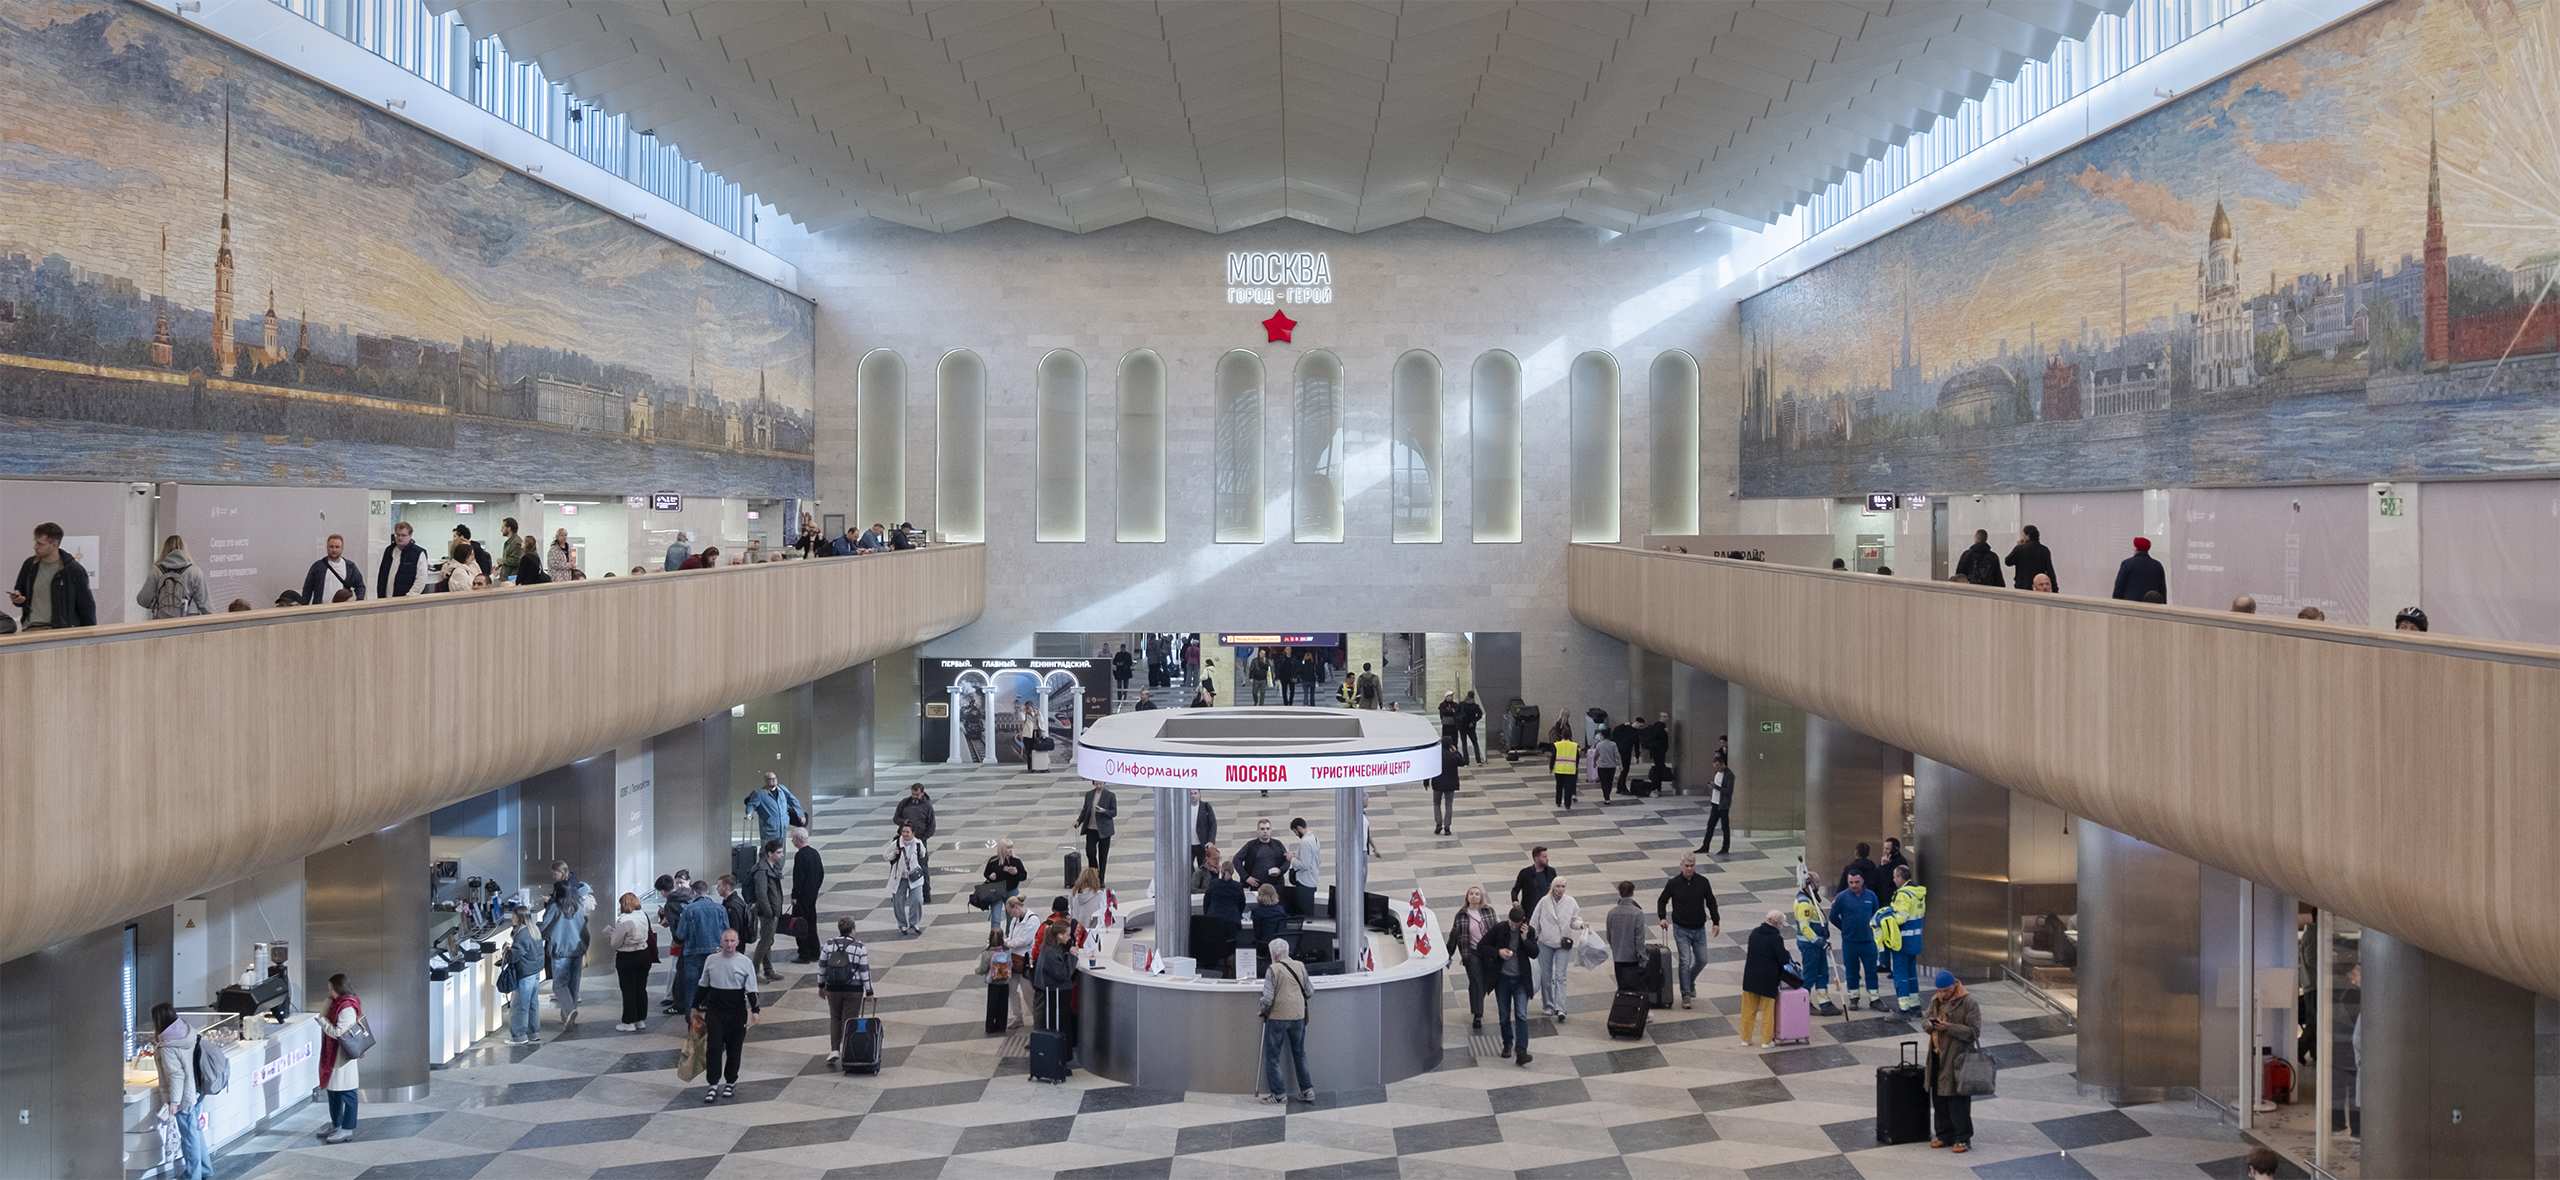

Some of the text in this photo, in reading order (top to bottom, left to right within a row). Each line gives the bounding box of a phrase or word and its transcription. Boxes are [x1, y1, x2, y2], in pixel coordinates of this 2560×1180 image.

[1228, 253, 1331, 284] МОСКВА
[1228, 287, 1274, 304] ГОРОД
[1286, 286, 1332, 304] ГЕРОЙ
[941, 659, 1092, 669] ПЕРВЫЙ. ГЛАВНЫЙ. ЛЕНИНГРАДСКИЙ.
[1117, 761, 1198, 779] Информация
[1225, 765, 1287, 783] МОСКВА
[1311, 760, 1411, 779] ТУРИСТИЧЕСКИЙ ЦЕНТР
